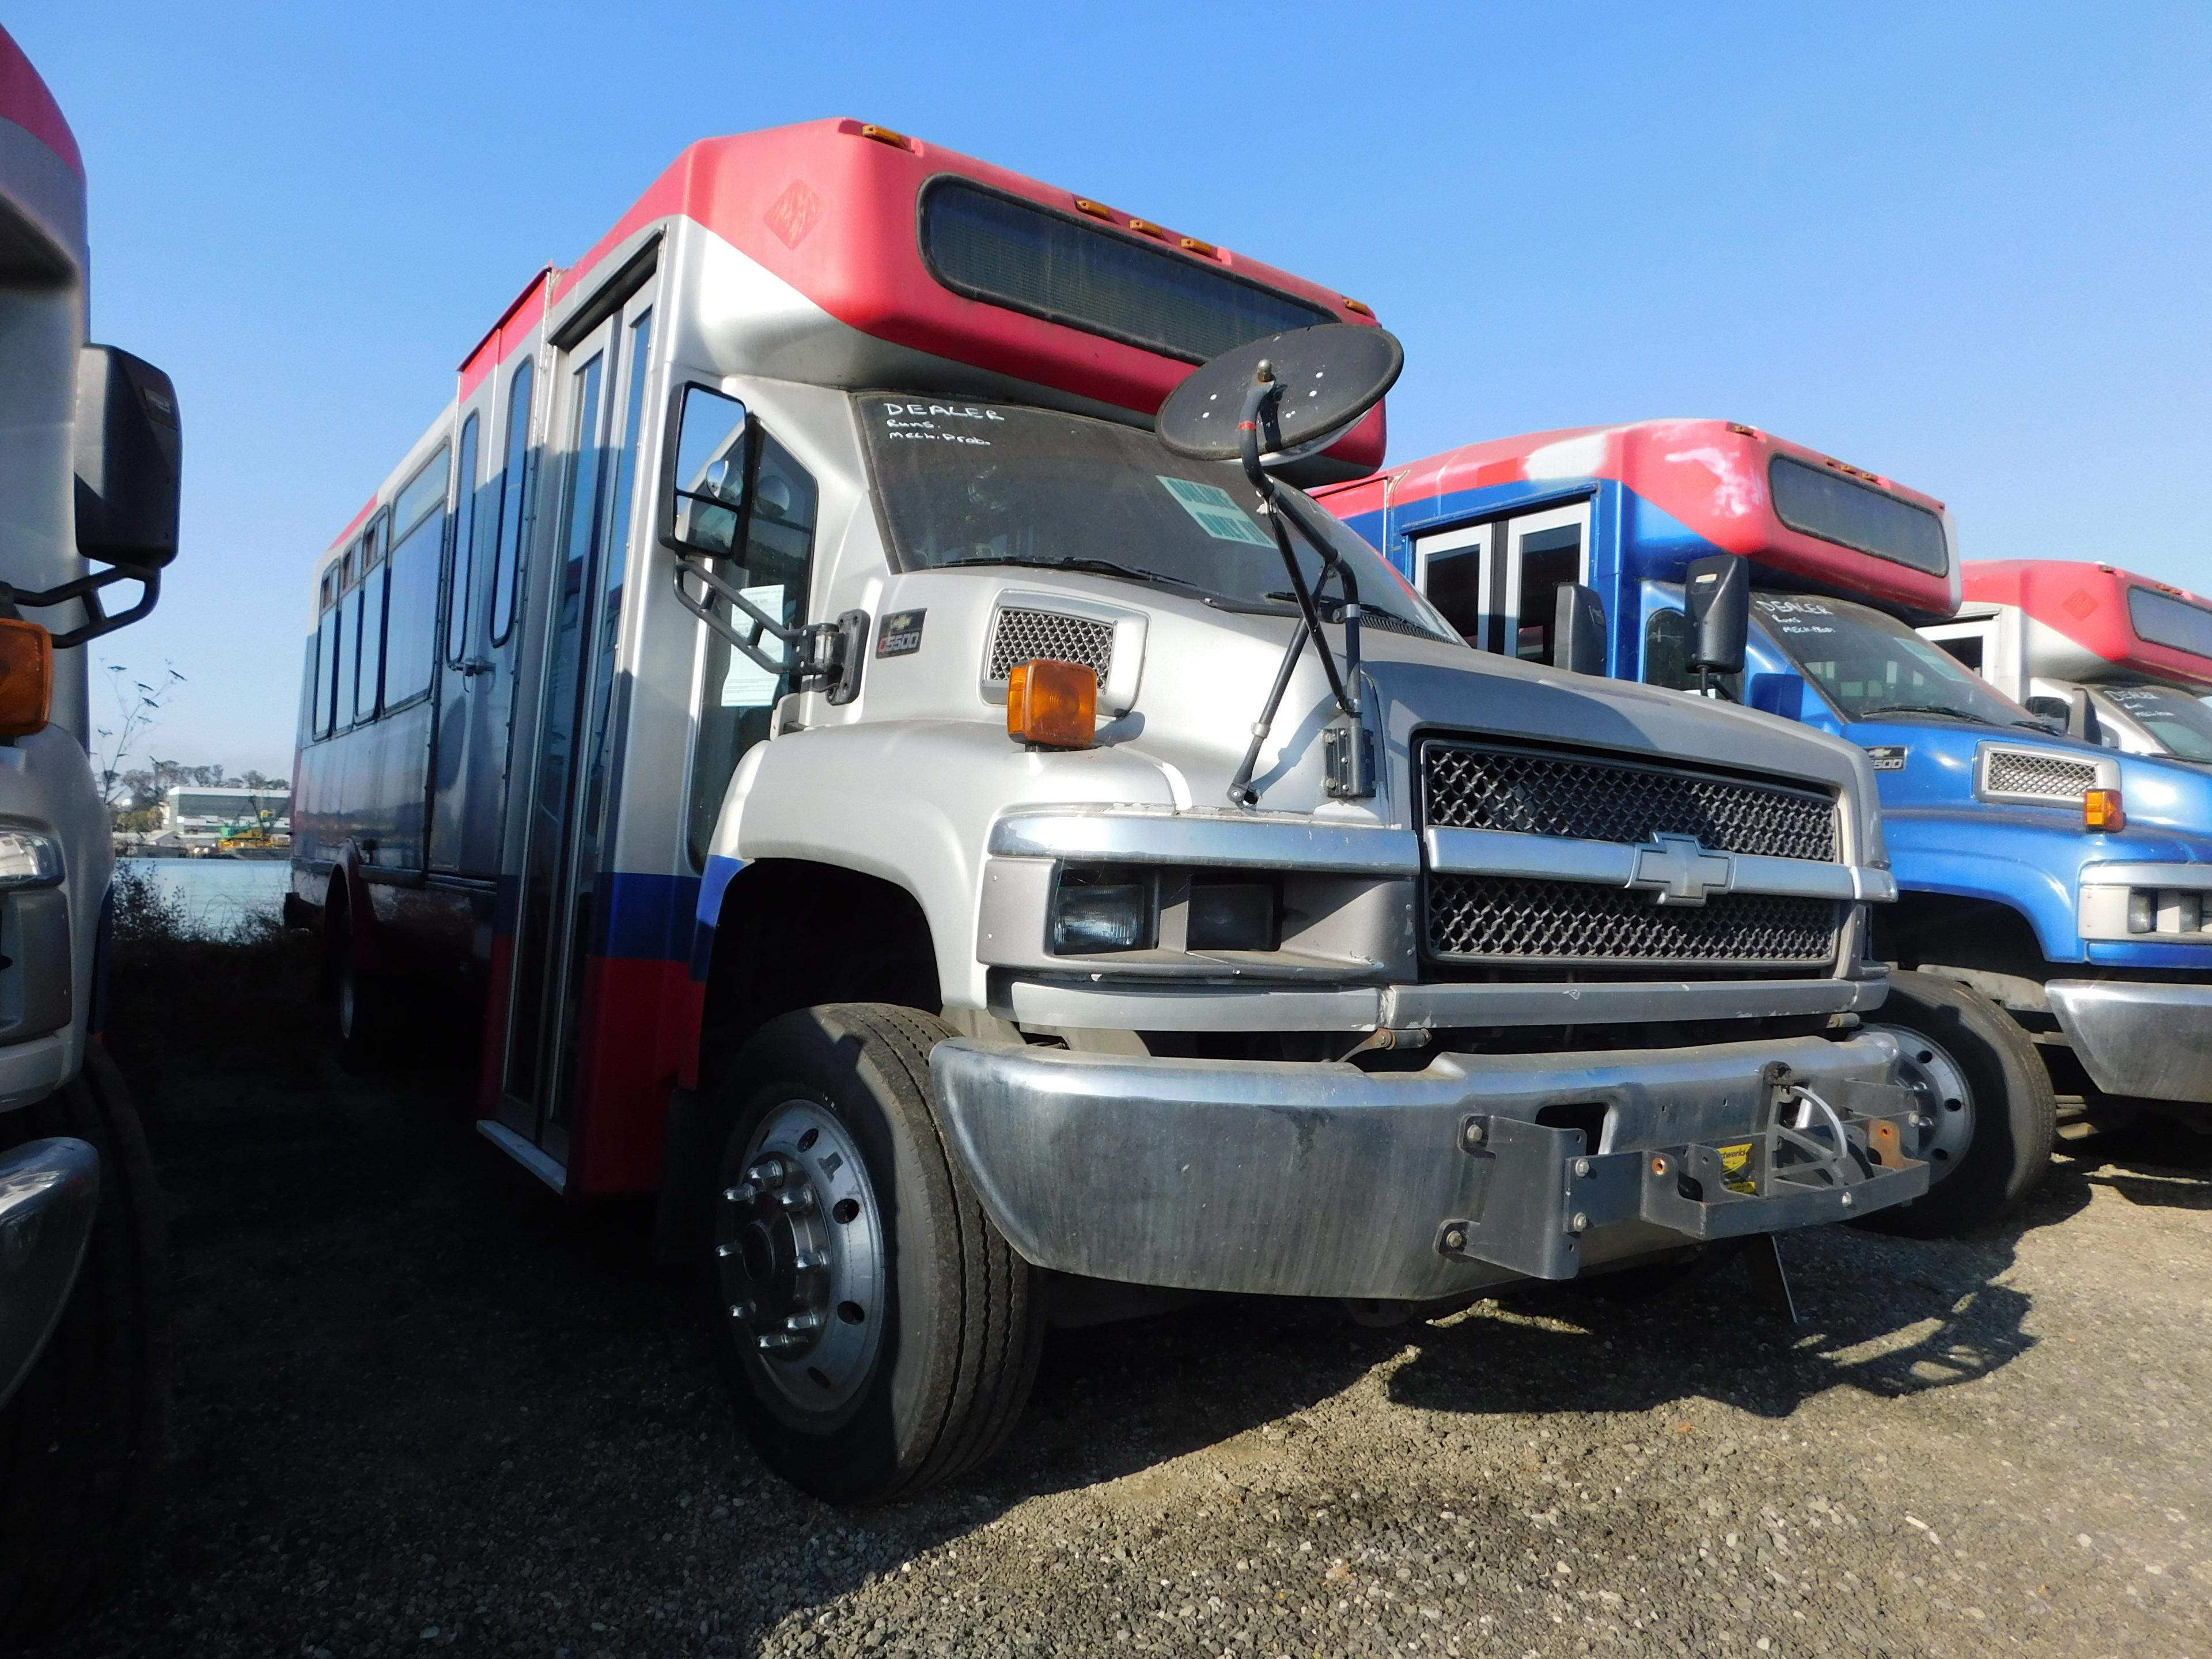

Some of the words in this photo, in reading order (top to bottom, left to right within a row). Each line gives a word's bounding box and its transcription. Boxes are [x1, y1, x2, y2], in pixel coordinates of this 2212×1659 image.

[883, 403, 1005, 421] DEALER
[1755, 600, 1834, 615] DEALER
[878, 631, 920, 653] C5500
